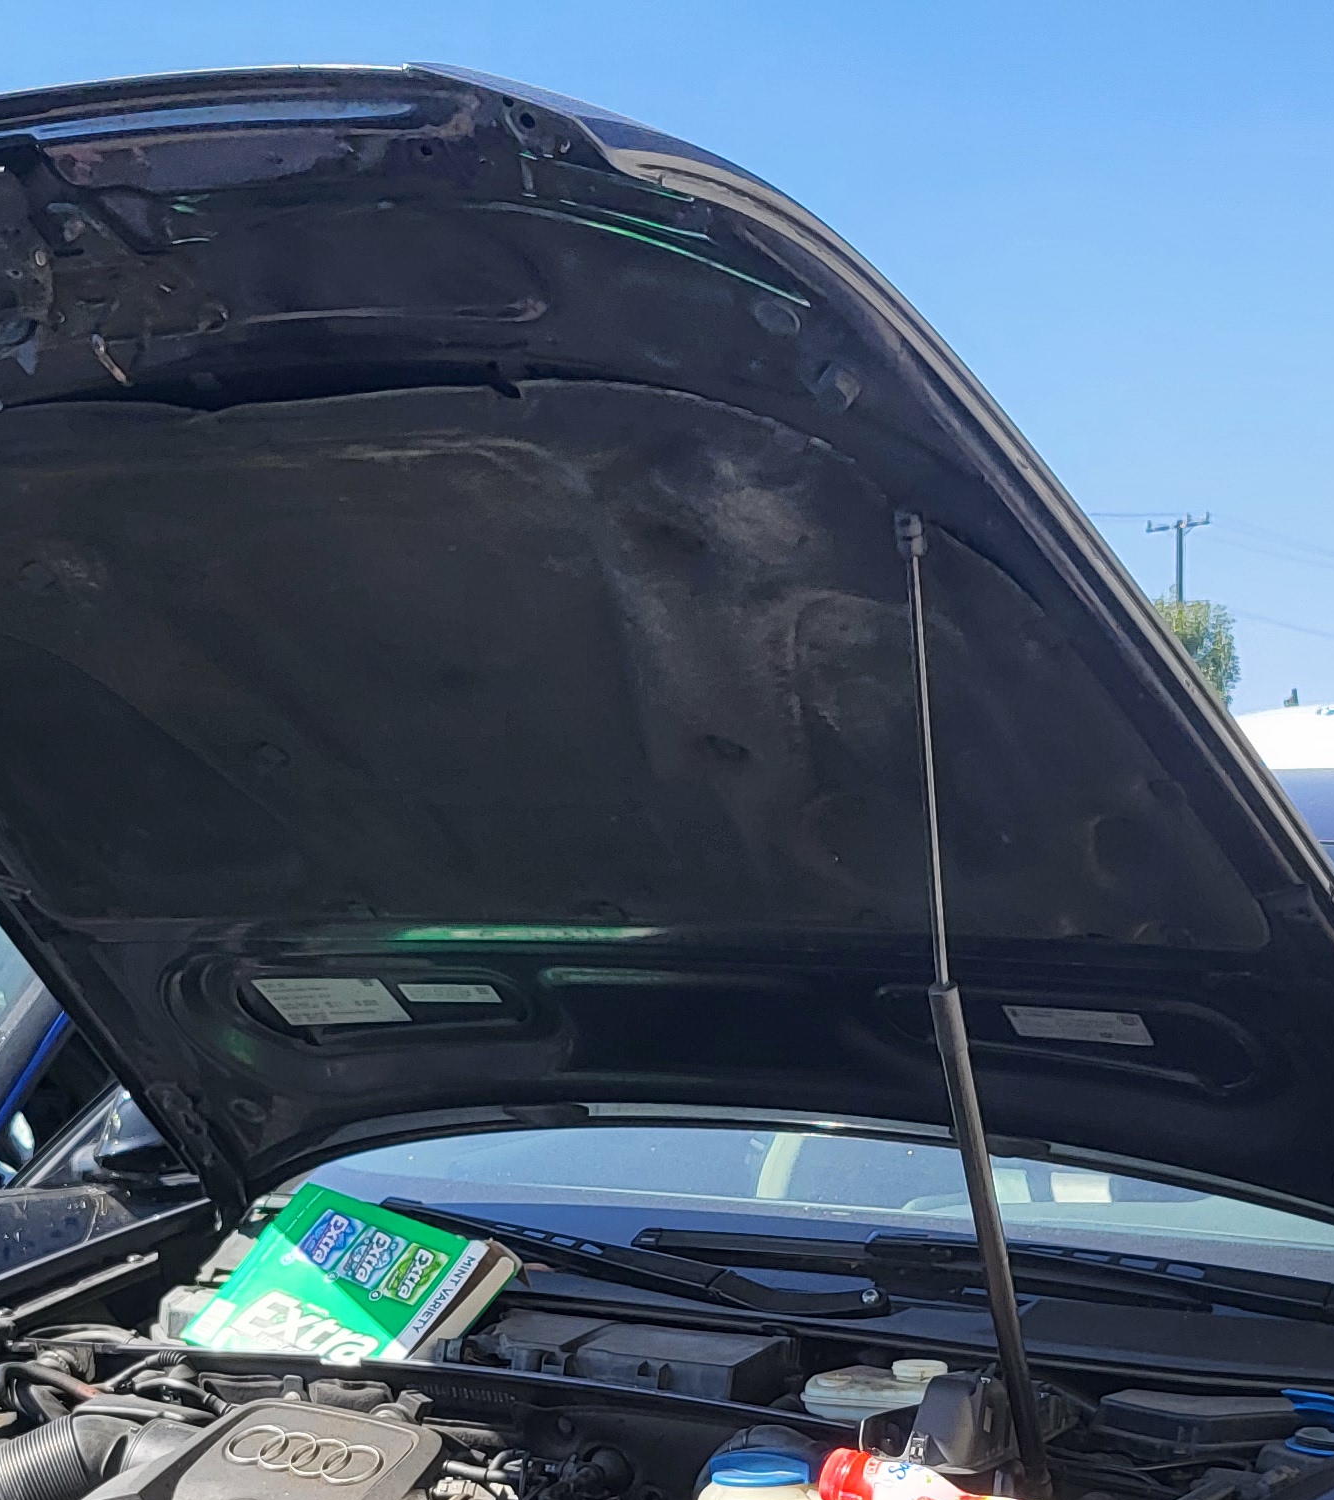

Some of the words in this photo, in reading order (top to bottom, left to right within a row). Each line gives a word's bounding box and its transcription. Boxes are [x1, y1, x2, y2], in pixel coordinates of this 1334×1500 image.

[312, 1214, 350, 1264] Extra
[355, 1231, 392, 1283] Extra
[397, 1248, 435, 1300] Extra
[449, 1255, 477, 1287] MINT
[231, 1291, 380, 1366] Extra
[412, 1287, 455, 1334] VARIETY
